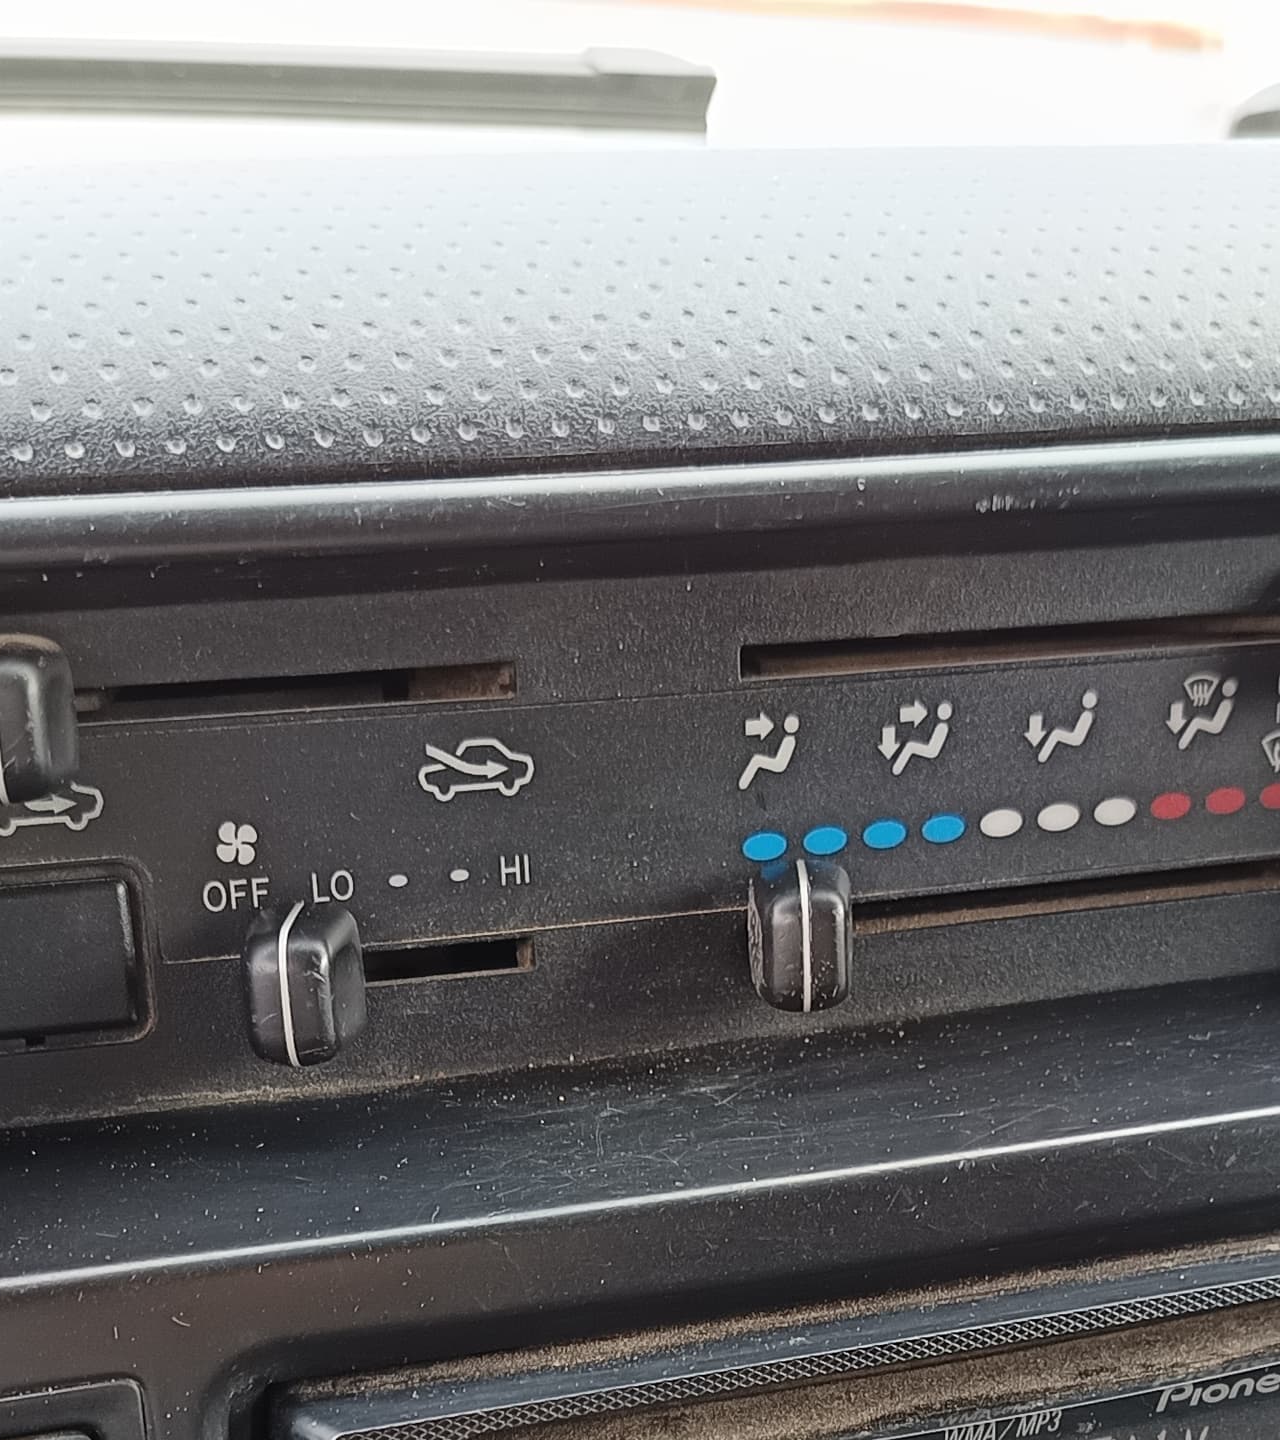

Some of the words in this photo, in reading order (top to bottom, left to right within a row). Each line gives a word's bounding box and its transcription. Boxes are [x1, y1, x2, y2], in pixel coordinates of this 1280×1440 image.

[202, 877, 269, 912] OFF
[312, 869, 354, 903] LO
[499, 854, 531, 887] HI
